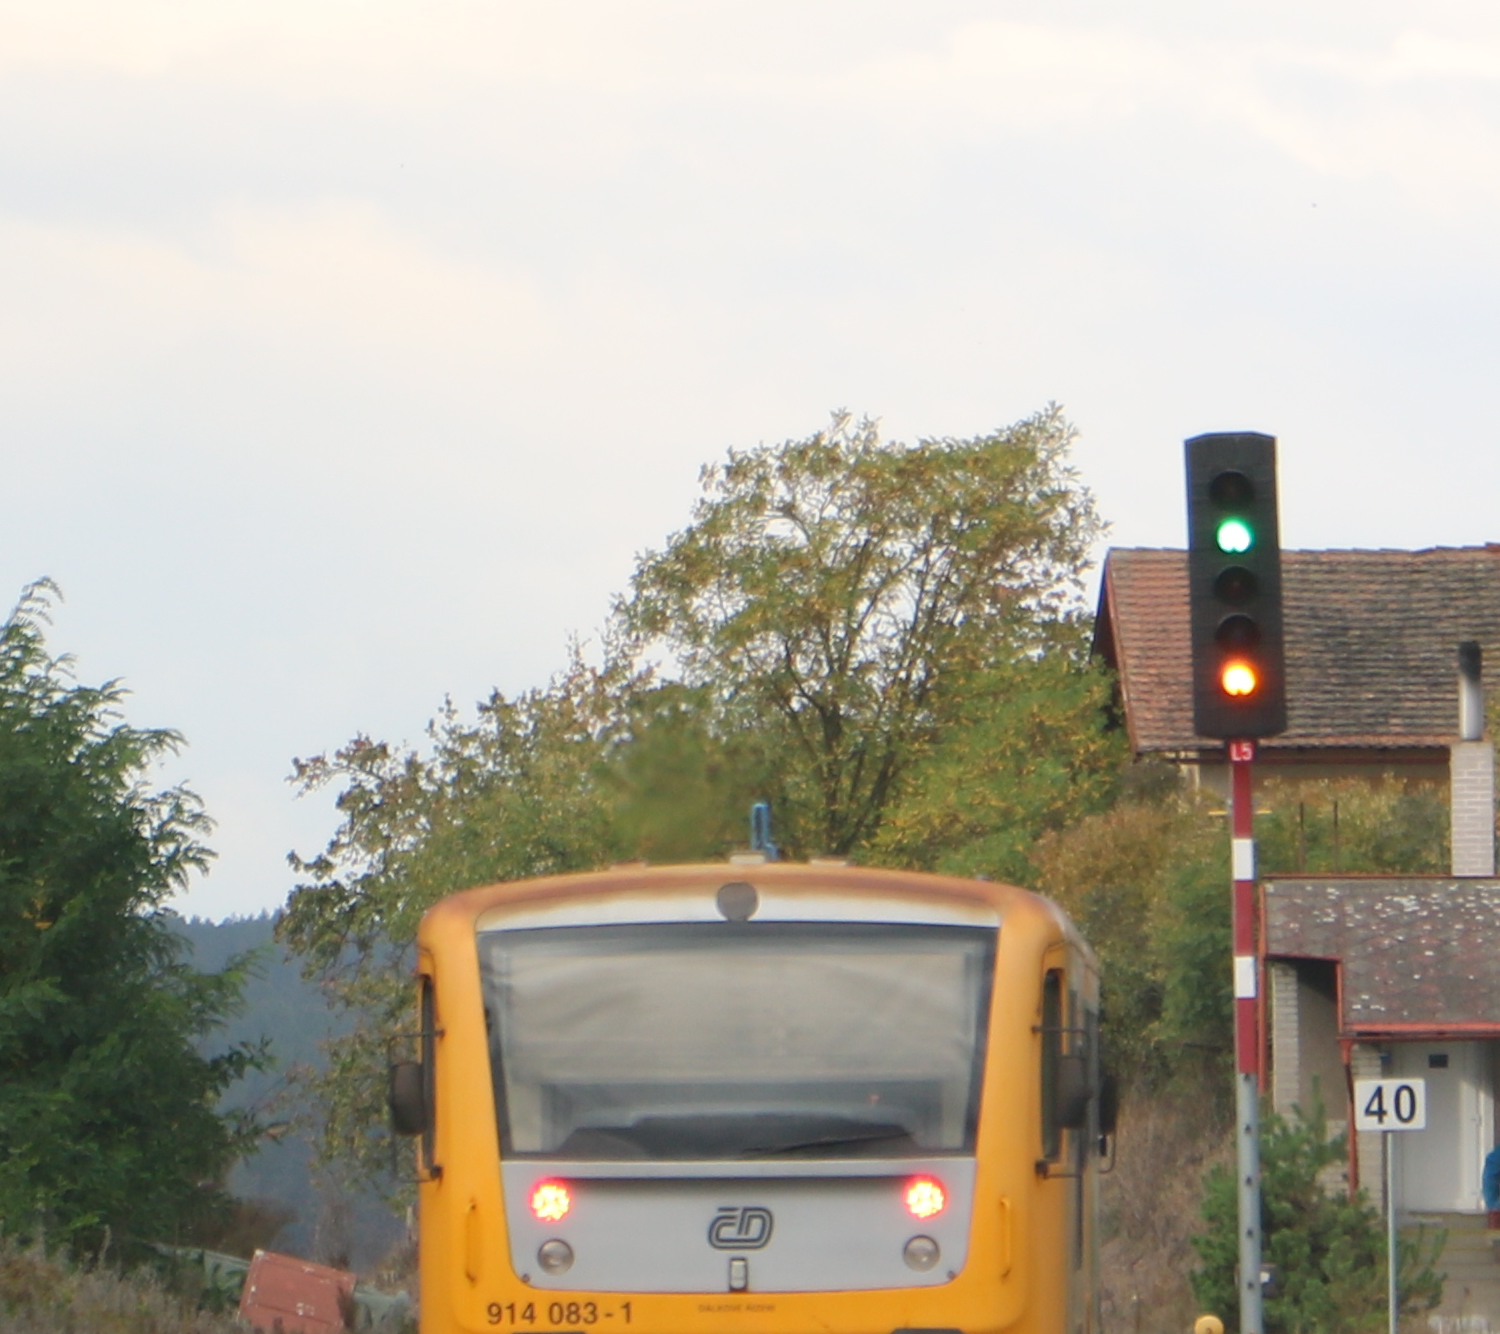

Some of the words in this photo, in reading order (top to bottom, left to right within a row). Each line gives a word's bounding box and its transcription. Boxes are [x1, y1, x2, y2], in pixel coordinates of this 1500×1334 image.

[1231, 742, 1252, 761] L5
[1364, 1084, 1416, 1125] 40
[487, 1302, 536, 1325] 914
